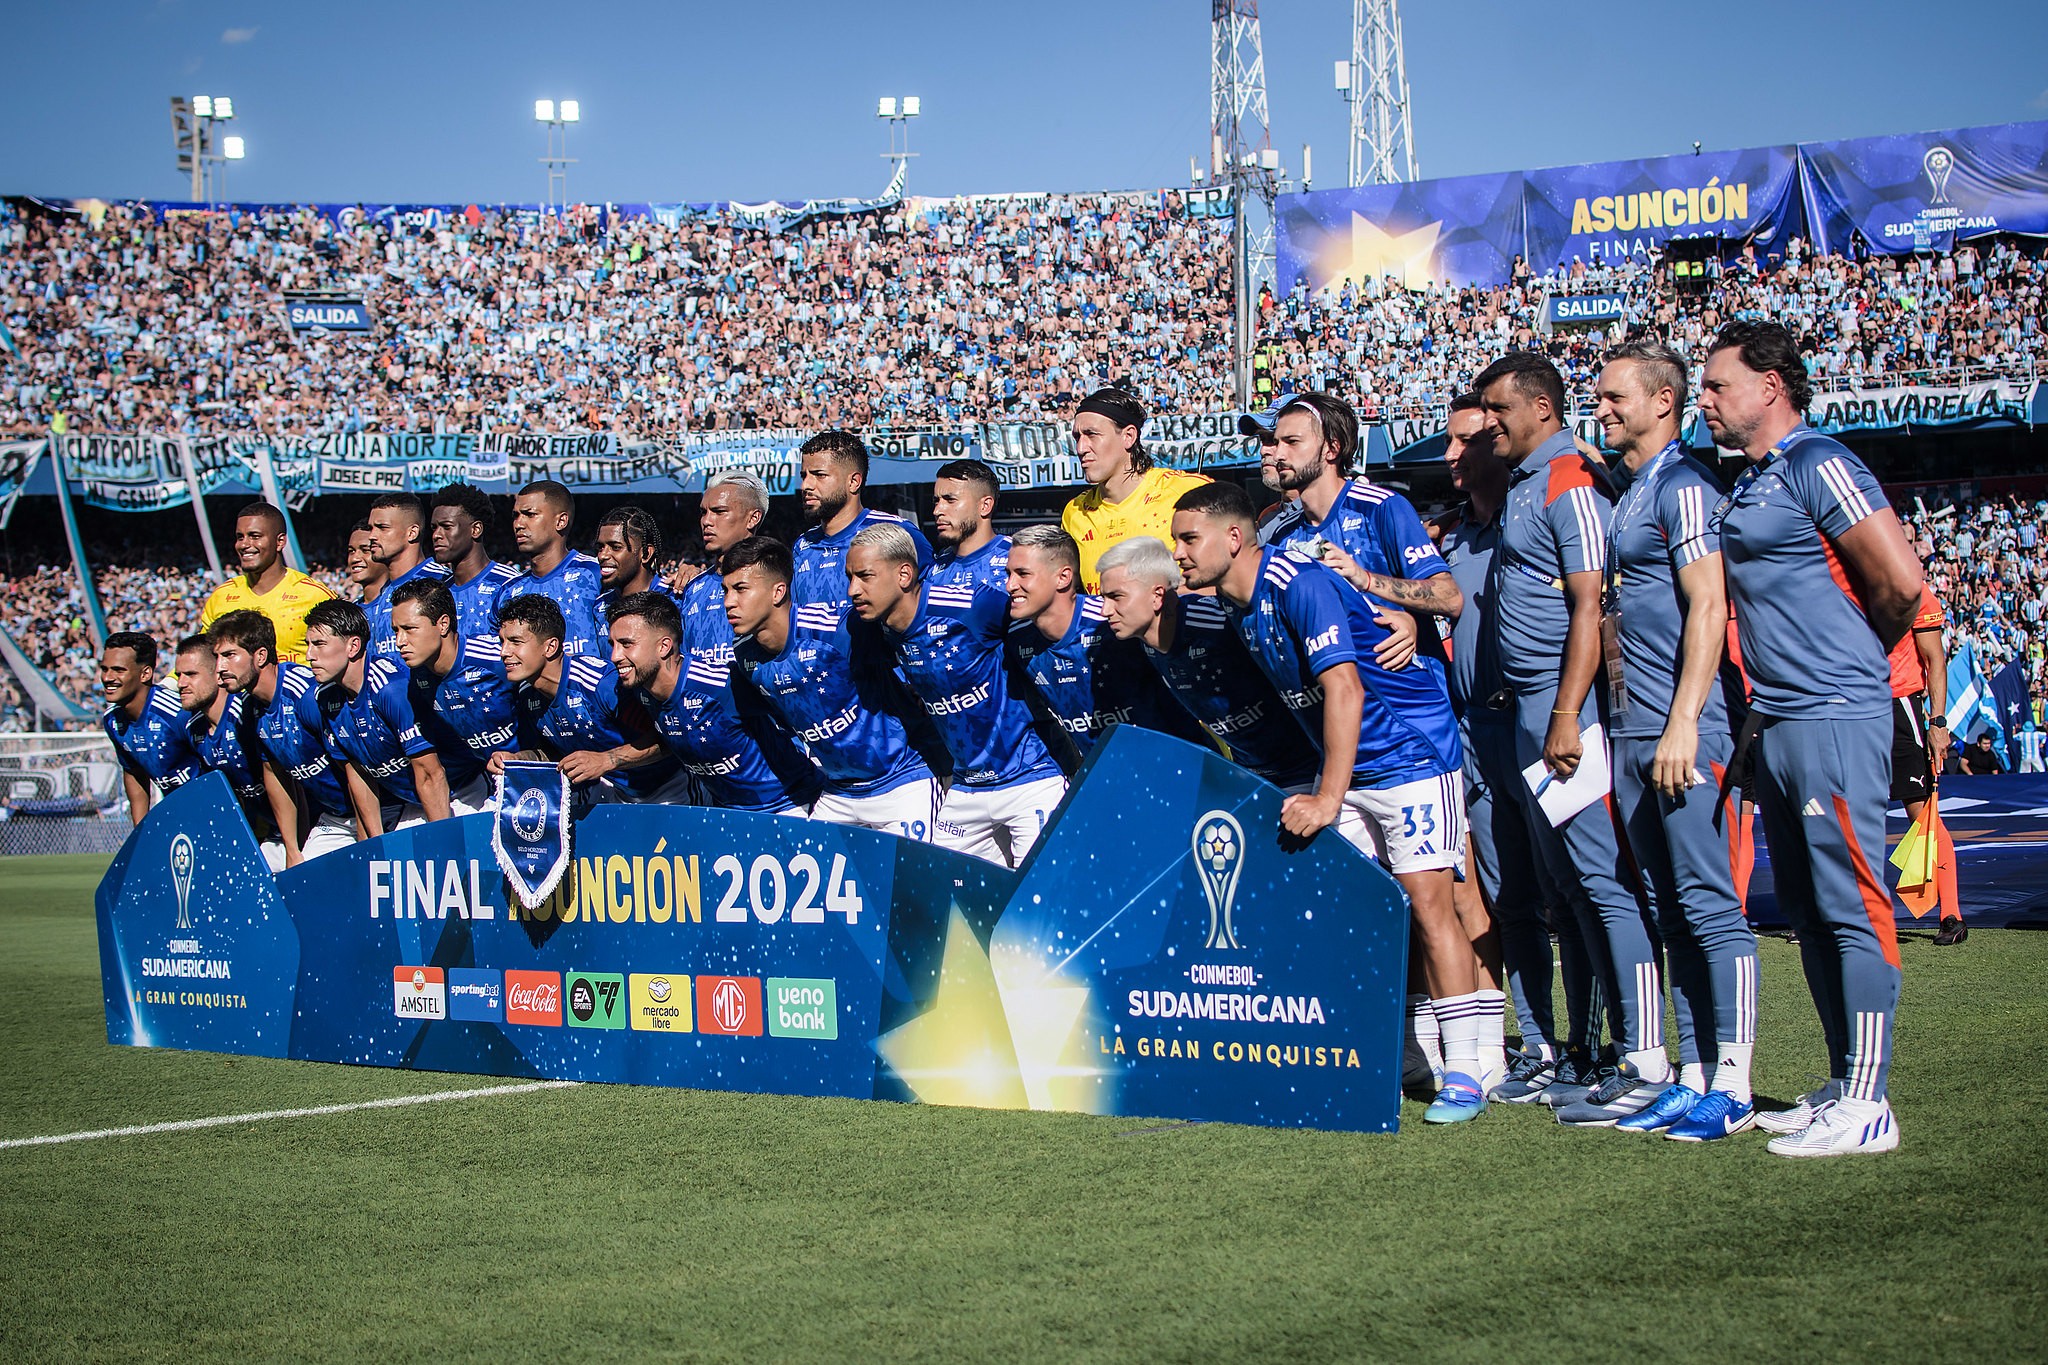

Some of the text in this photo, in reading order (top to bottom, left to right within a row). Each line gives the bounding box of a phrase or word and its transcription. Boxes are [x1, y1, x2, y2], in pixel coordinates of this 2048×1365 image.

[1571, 176, 1748, 235] ASUNCIÓN
[1884, 216, 1998, 238] SUDMERICANA
[291, 307, 359, 324] SALIDA
[1557, 298, 1624, 317] SALIDA
[1882, 389, 2002, 423] VARELA
[68, 438, 152, 468] CLAYPOLE
[388, 435, 469, 457] NORTE
[484, 433, 500, 453] MI
[505, 435, 547, 456] AMOR
[551, 434, 608, 455] ETERNO
[688, 434, 711, 454] LOS
[715, 430, 746, 451] PIBES
[752, 430, 766, 448] DE
[770, 429, 794, 447] SAN
[869, 436, 965, 458] SOLANO
[324, 468, 361, 484] JOSE
[375, 471, 404, 488] PAZ
[560, 451, 692, 484] GUTIERREZ
[1305, 624, 1340, 657] Surf
[922, 681, 990, 716] betfair
[1209, 700, 1264, 736] etfair
[466, 722, 514, 750] etfair
[289, 753, 330, 780] etfair
[1401, 803, 1436, 838] 33
[368, 859, 494, 920] FINAL
[714, 852, 864, 925] 2024
[141, 957, 231, 979] SUDAMERICANA
[129, 990, 248, 1009] LA GRAN CONQUISTA
[451, 983, 499, 997] sportingbet
[573, 988, 592, 1002] EA
[777, 987, 824, 1006] ueno
[400, 996, 440, 1014] AMSTEL
[573, 1002, 592, 1011] SPORTS
[643, 1006, 680, 1018] mercado
[715, 984, 744, 1027] MG
[1128, 989, 1326, 1024] SUDAMERICANA
[652, 1017, 671, 1029] libre
[778, 1006, 826, 1030] bank
[1100, 1036, 1361, 1069] LA GRAN CONQUISTA
